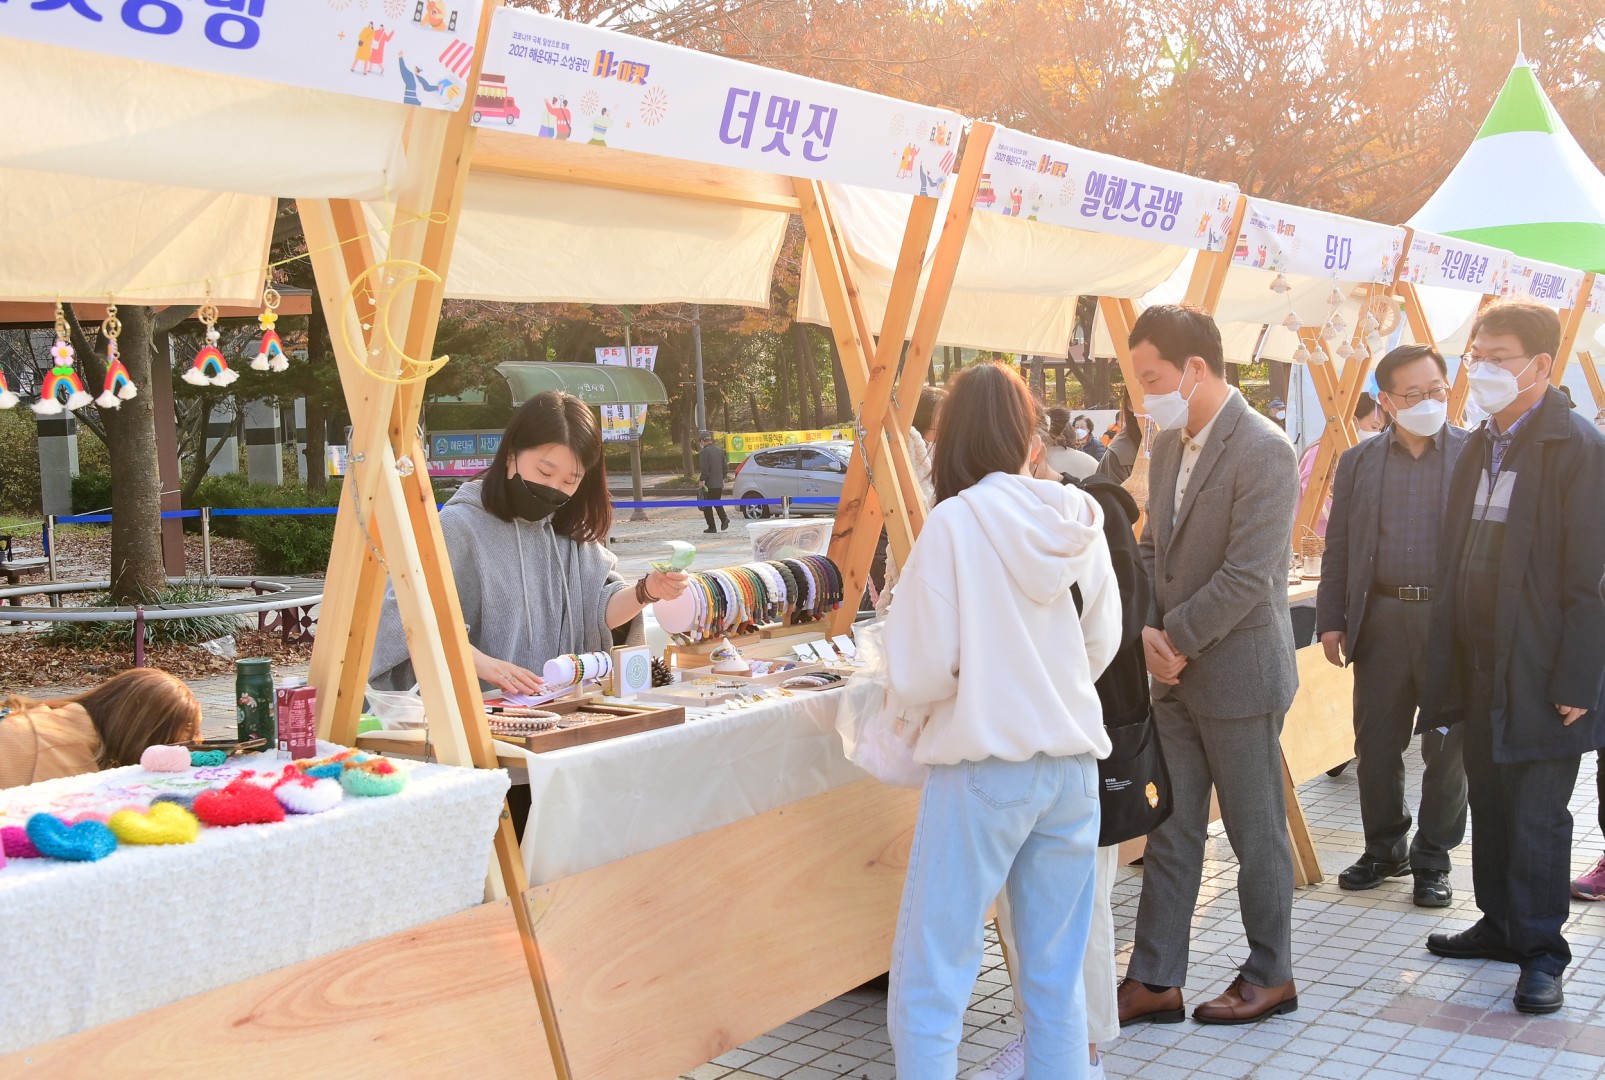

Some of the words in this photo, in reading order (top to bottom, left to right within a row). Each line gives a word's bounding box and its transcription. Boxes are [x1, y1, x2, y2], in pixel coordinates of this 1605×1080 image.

[508, 43, 528, 58] 2021
[528, 47, 560, 66] 해운대구
[560, 53, 590, 73] 소상공인
[719, 87, 838, 162] 더멋진
[994, 151, 1006, 162] 2021
[1080, 170, 1183, 231] 엘헨즈공방
[1324, 234, 1351, 270] 담다
[1441, 249, 1489, 284] 작은미술관
[450, 440, 474, 451] 해운대구
